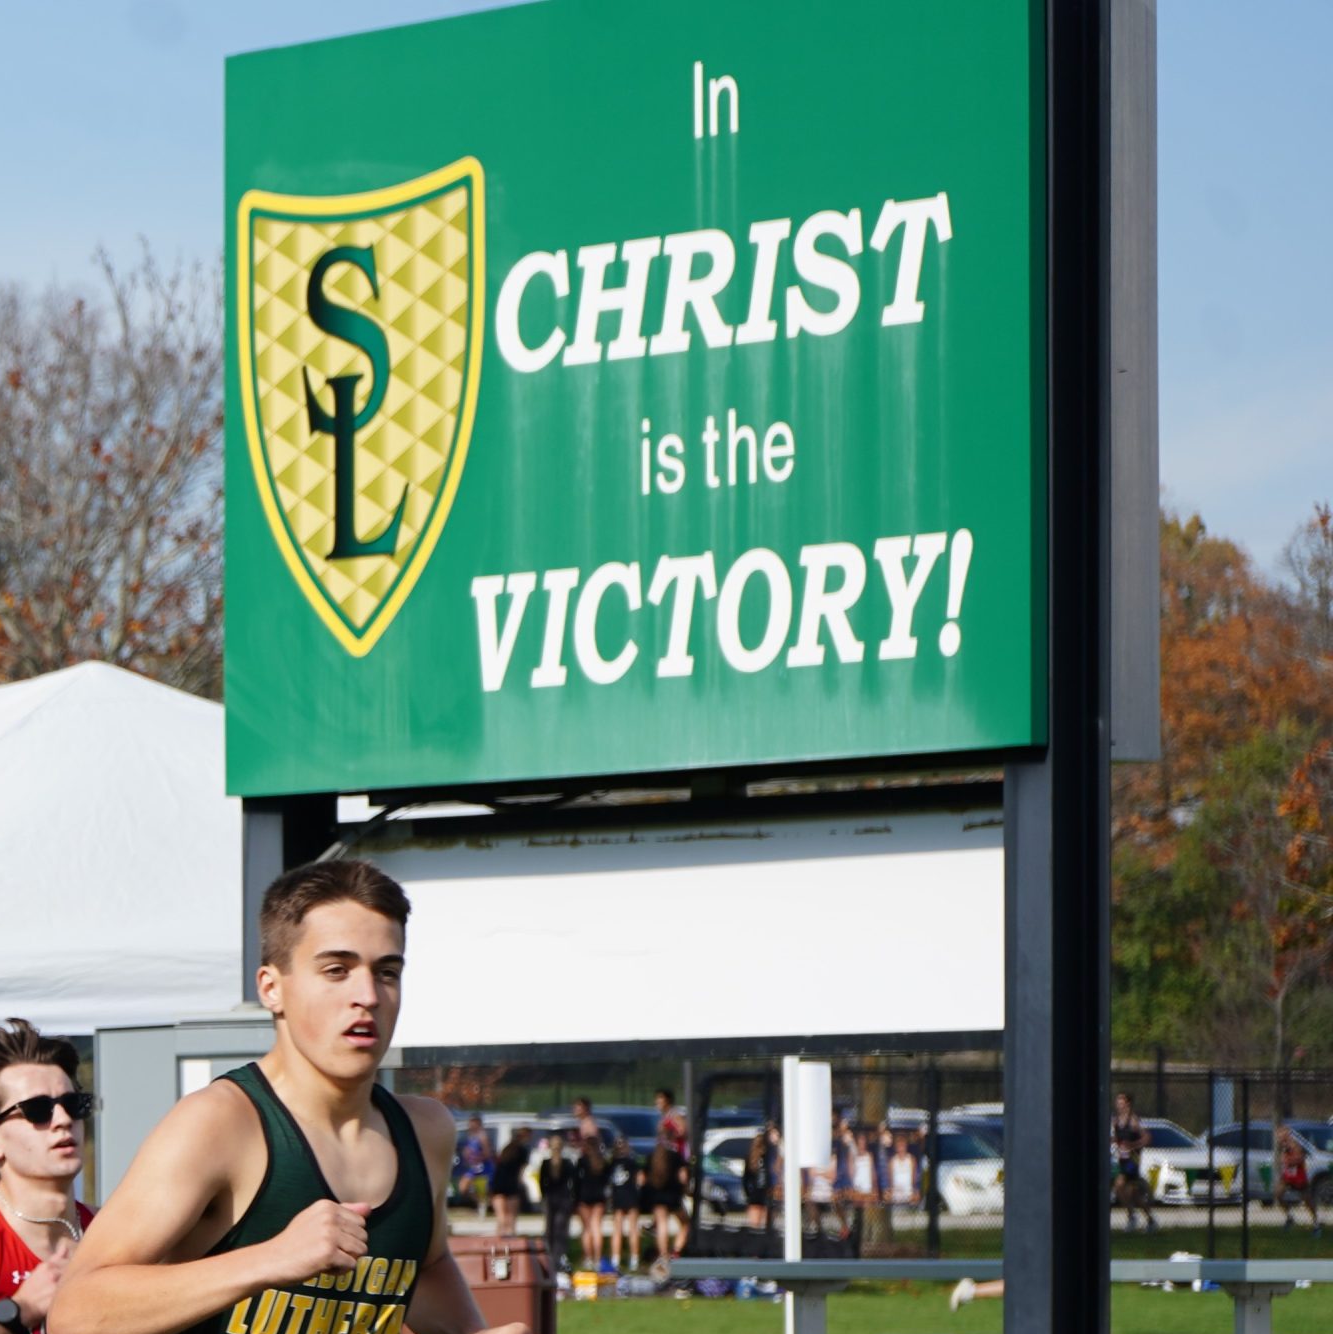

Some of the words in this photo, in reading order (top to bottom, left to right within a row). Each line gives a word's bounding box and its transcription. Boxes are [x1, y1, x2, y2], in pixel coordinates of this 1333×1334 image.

[693, 60, 740, 140] In
[493, 191, 954, 374] CHRIST
[640, 418, 687, 495] is
[703, 408, 796, 490] the
[469, 528, 975, 693] VICTORY!
